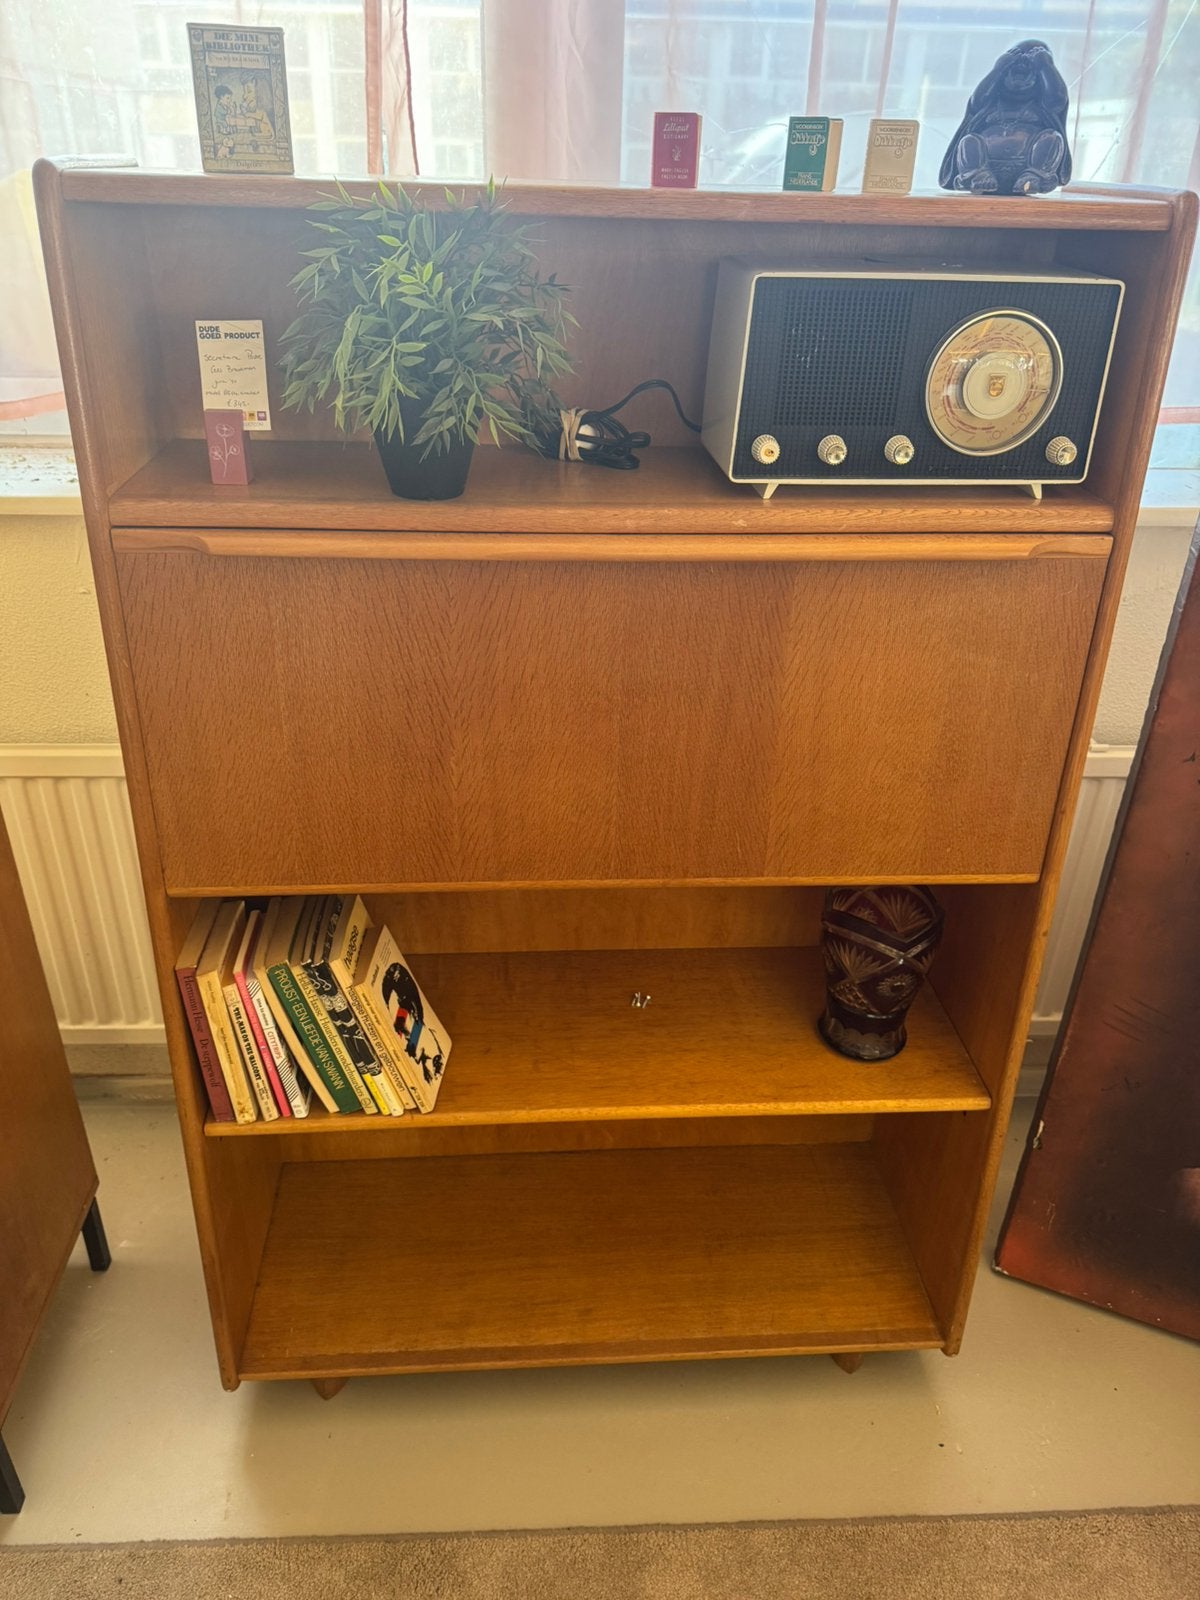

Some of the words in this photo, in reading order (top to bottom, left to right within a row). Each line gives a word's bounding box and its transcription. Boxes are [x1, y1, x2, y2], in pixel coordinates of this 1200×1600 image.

[344, 925, 359, 970] haagse
[182, 974, 201, 1011] Hermann
[273, 967, 299, 1003] PROUST
[295, 971, 311, 990] Hella
[291, 1001, 309, 1022] EEN
[344, 984, 366, 1016] haagse
[191, 1011, 206, 1033] Hesse
[232, 1007, 242, 1021] THE
[235, 1019, 247, 1035] MAN
[241, 1034, 249, 1042] ON
[300, 1018, 323, 1048] LIEFDE
[319, 1015, 341, 1047] Huurders
[360, 1013, 381, 1043] huizen
[198, 1037, 210, 1050] De
[243, 1042, 253, 1055] THE
[265, 1030, 283, 1060] CITYTRIPS
[314, 1043, 331, 1063] VAN
[334, 1046, 342, 1055] en
[374, 1040, 384, 1052] en
[247, 1054, 262, 1081] BALCONY
[322, 1059, 345, 1091] SWANN
[337, 1052, 366, 1097] onderhuurders
[378, 1051, 406, 1093] gebouwen
